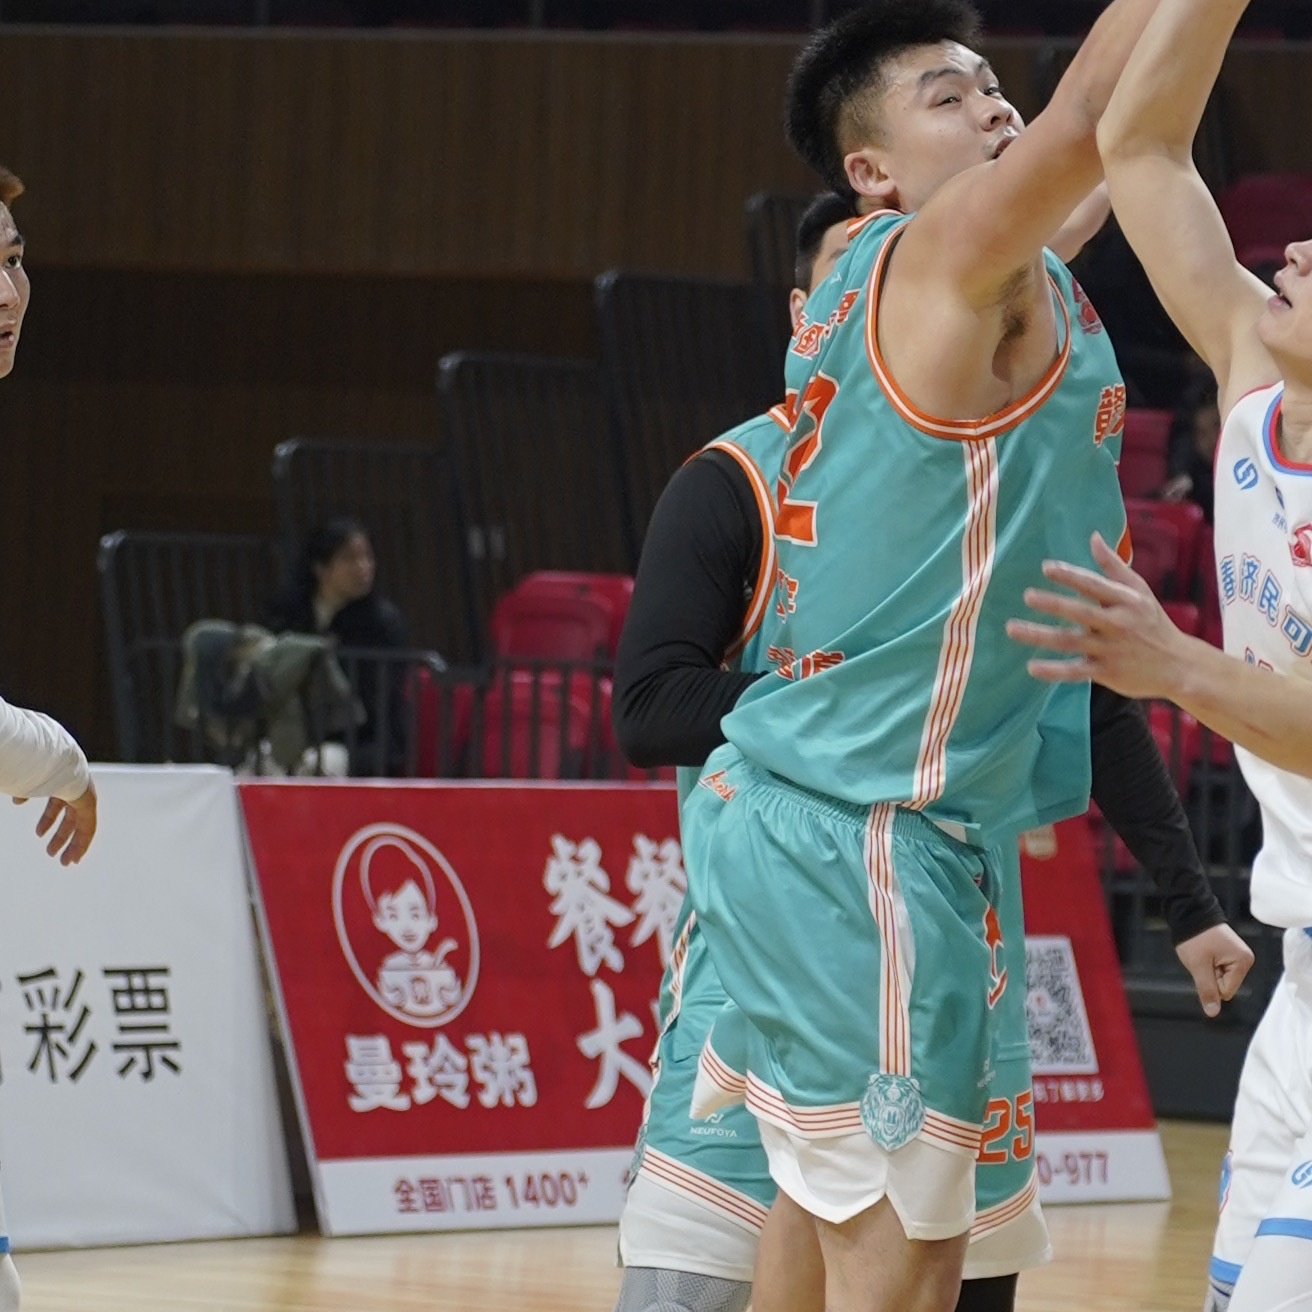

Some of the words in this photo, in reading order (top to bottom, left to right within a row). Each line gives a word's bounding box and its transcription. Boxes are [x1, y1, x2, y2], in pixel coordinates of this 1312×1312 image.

[17, 968, 181, 1082] 彩票
[576, 978, 660, 1110] 大
[343, 1032, 538, 1113] 曼玲粥
[689, 1126, 738, 1138] NEUFOYA
[975, 1089, 1034, 1165] 25
